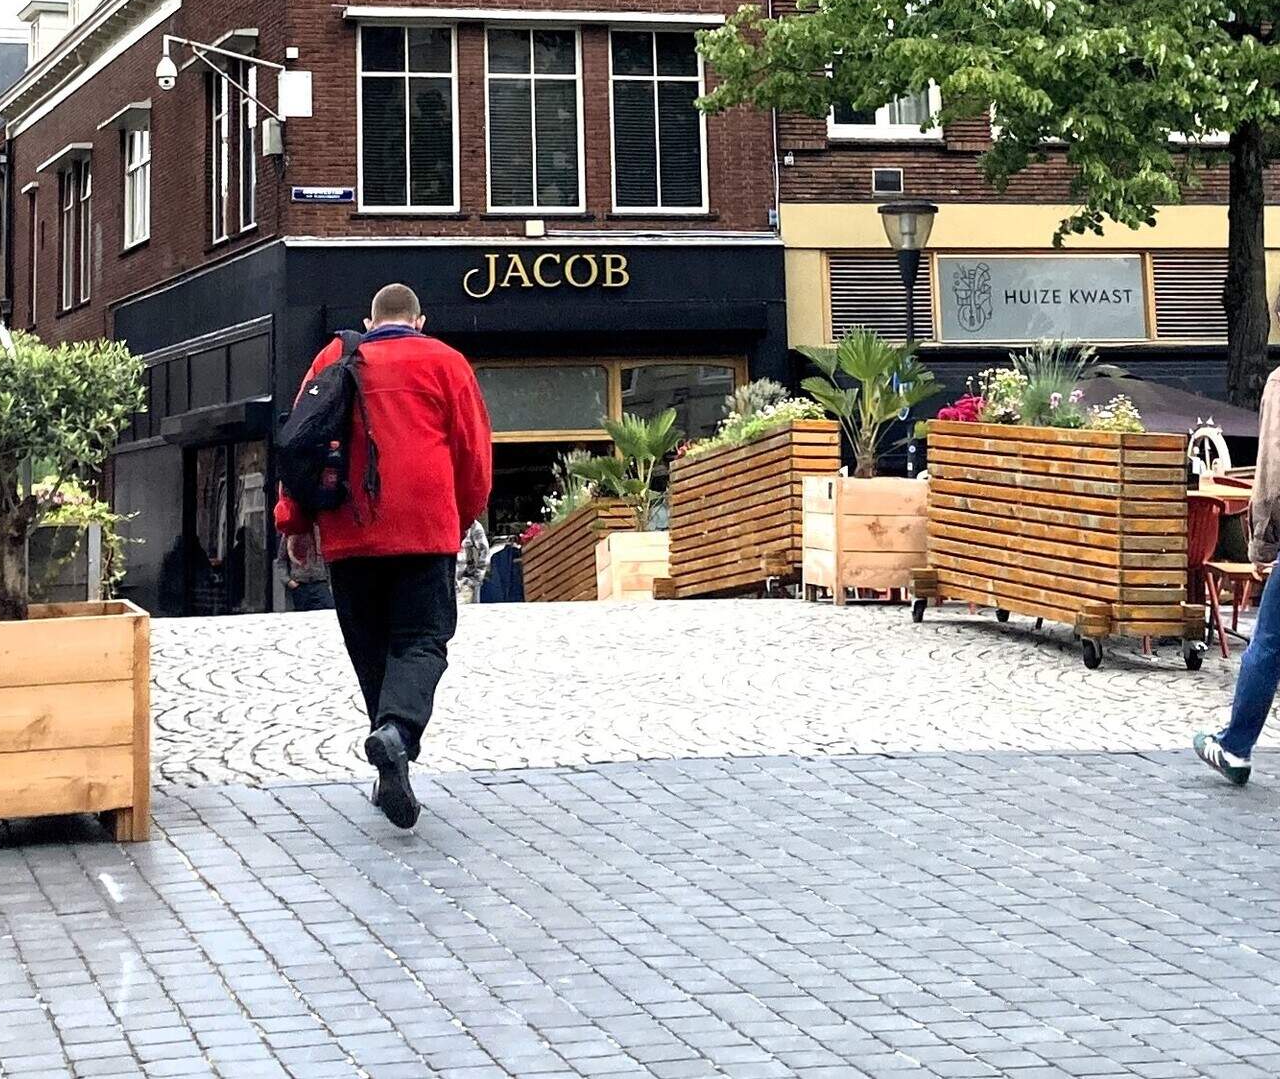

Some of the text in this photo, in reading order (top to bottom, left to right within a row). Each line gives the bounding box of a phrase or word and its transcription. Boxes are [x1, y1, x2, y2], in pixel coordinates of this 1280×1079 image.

[463, 253, 630, 298] JACOB
[1004, 289, 1132, 304] HUIZE KWAST
